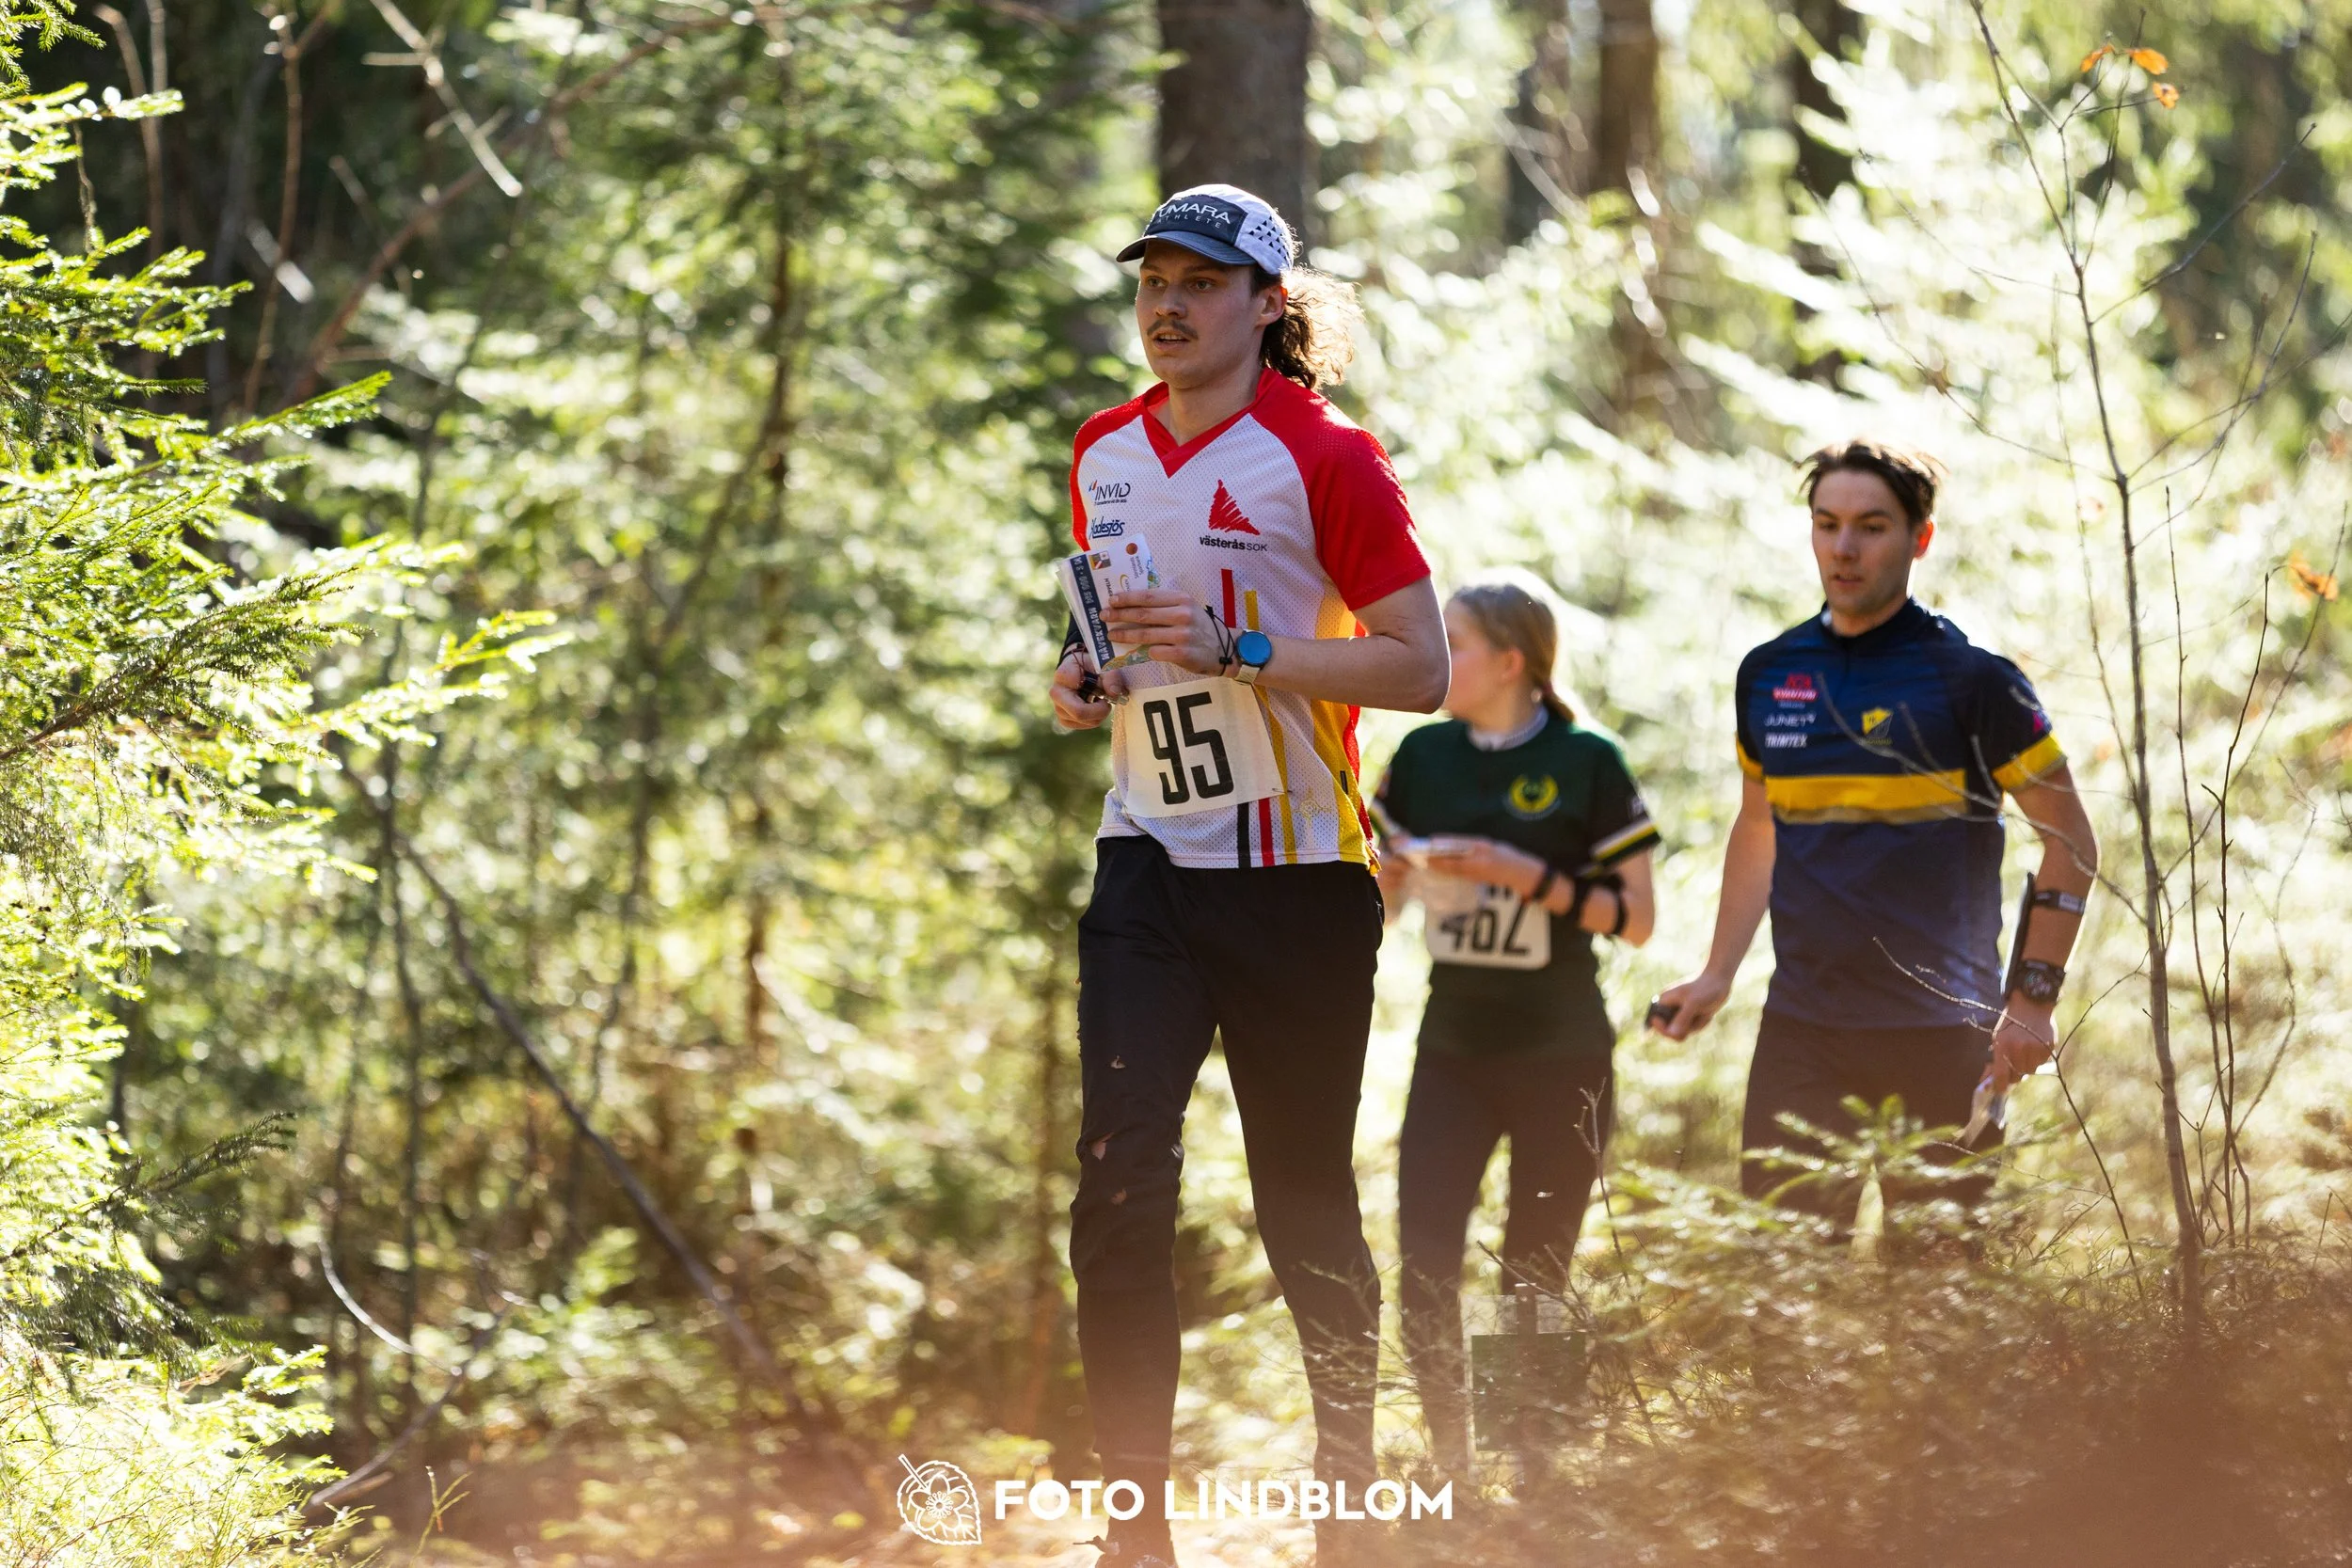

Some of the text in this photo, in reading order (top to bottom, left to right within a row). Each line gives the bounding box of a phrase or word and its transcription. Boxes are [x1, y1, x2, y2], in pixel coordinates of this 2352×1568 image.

[1156, 214, 1222, 229] ATHLETE
[1159, 202, 1231, 224] UMARA
[1094, 482, 1131, 501] INVID
[1143, 691, 1234, 805] 95
